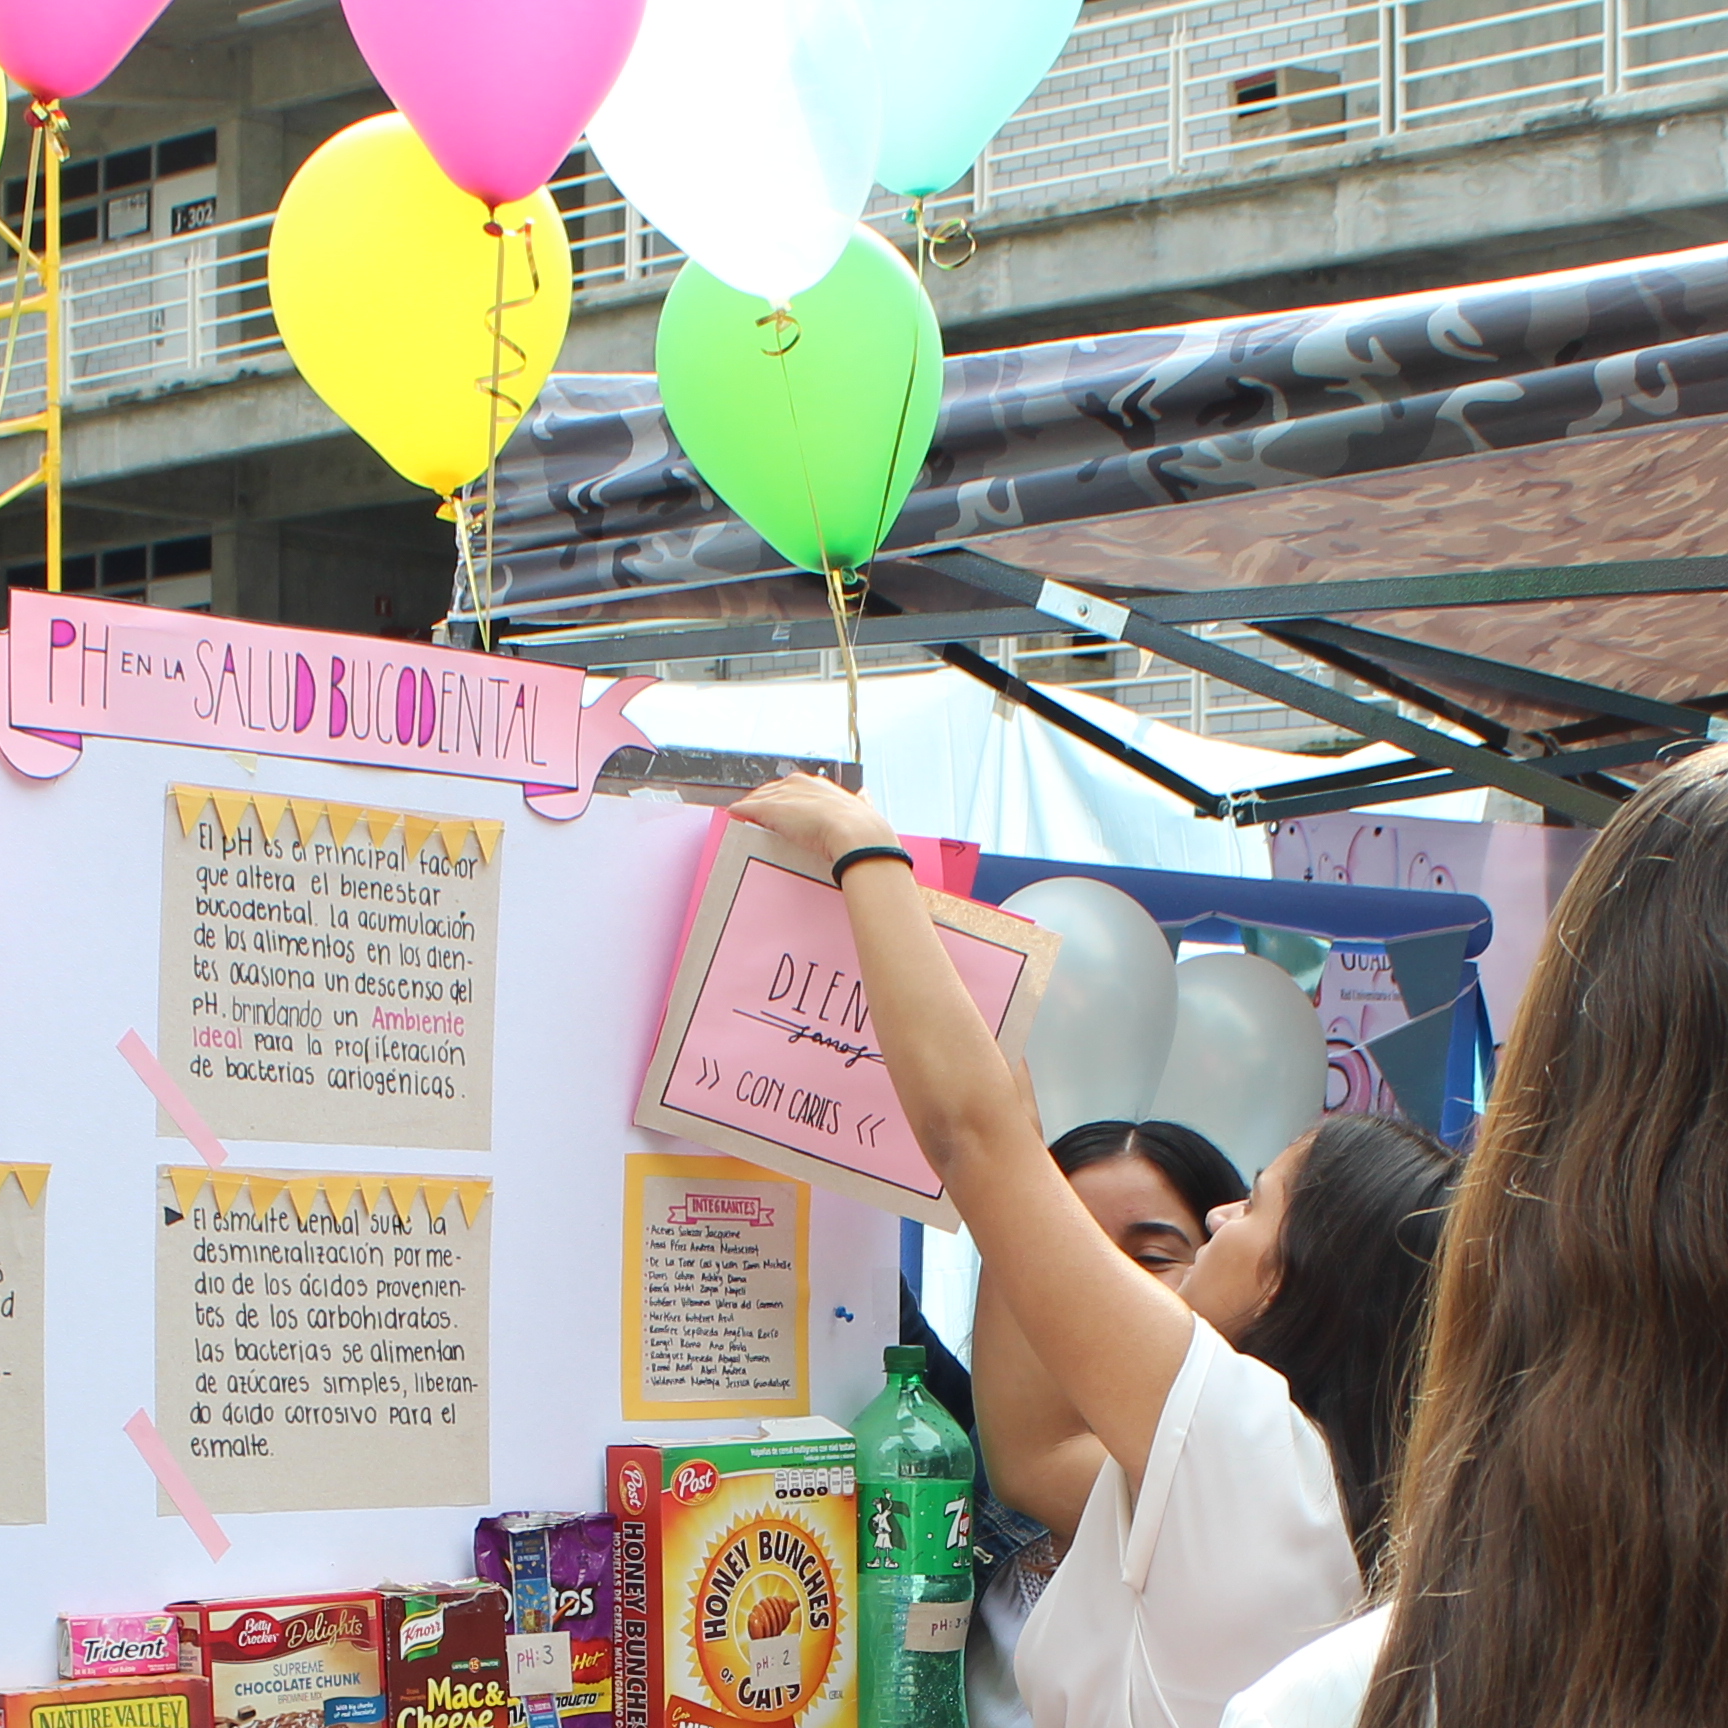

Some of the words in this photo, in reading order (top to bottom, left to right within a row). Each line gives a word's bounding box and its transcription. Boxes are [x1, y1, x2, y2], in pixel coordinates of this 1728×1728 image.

[49, 618, 109, 709] PH
[121, 652, 151, 675] EN
[164, 658, 185, 682] LA
[193, 639, 315, 734] SALUD
[329, 655, 547, 766] BUCODENTAL
[199, 823, 212, 850] El
[222, 826, 252, 860] pH
[264, 839, 283, 860] es
[315, 843, 405, 872] principal
[196, 865, 229, 895] que
[236, 865, 295, 892] altera
[311, 872, 329, 896] el
[341, 874, 441, 906] bienestar
[196, 896, 319, 927] bucodental.
[358, 910, 475, 942] acumulación
[194, 922, 216, 950] de
[224, 924, 247, 952] los
[254, 929, 355, 964] alimentos
[367, 942, 391, 966] en
[399, 943, 421, 967] los
[427, 946, 473, 971] dien-
[193, 954, 219, 982] tes
[230, 961, 315, 989] ocasiona
[325, 971, 349, 992] un
[355, 972, 443, 1001] descenso
[450, 977, 472, 1005] del
[233, 996, 322, 1029] brindando
[334, 1009, 358, 1027] un
[372, 1005, 465, 1037] Ambiente
[192, 1026, 242, 1049] Ideal
[254, 1032, 294, 1052] para
[307, 1033, 322, 1056] la
[190, 1055, 213, 1078] de
[225, 1056, 314, 1085] bacterias
[328, 1066, 466, 1100] cariogénicas.
[736, 1070, 785, 1112] CON
[788, 1089, 842, 1135] CARIES
[194, 1208, 205, 1231] El
[213, 1207, 290, 1233] esmalte
[429, 1211, 447, 1235] la
[693, 1198, 756, 1215] INTEGRANTES
[194, 1237, 384, 1267] desmineralización
[394, 1247, 420, 1267] por
[194, 1272, 224, 1295] dio
[232, 1272, 254, 1295] de
[264, 1273, 291, 1297] los
[300, 1273, 368, 1297] ácidos
[376, 1279, 466, 1299] provenien-
[195, 1302, 224, 1328] tes
[235, 1303, 259, 1329] de
[270, 1303, 298, 1329] los
[307, 1305, 458, 1330] carbohidratos.
[234, 1338, 332, 1362] bacterias
[342, 1343, 364, 1363] se
[370, 1339, 465, 1363] alimentan
[195, 1372, 217, 1394] de
[227, 1368, 310, 1395] azúcares
[323, 1372, 408, 1398] simples,
[190, 1402, 211, 1424] do
[285, 1406, 377, 1425] corrosivo
[389, 1405, 432, 1425] para
[441, 1403, 456, 1425] el
[191, 1433, 274, 1458] esmalte.
[624, 1469, 643, 1508] Post
[678, 1467, 713, 1498] Post
[613, 1532, 621, 1587] HOJUELAS
[623, 1522, 646, 1614] HONEY
[614, 1589, 621, 1602] DE
[703, 1539, 751, 1641] HONEY
[758, 1530, 829, 1629] BUNCHES
[238, 1631, 279, 1647] Crocker
[245, 1618, 272, 1633] Betty
[285, 1609, 363, 1649] Delights
[402, 1620, 441, 1644] Knorr
[614, 1606, 622, 1645] CEREAL
[81, 1636, 168, 1665] Trident
[517, 1648, 539, 1674] pH:
[543, 1645, 554, 1665] 3
[572, 1650, 605, 1671] Hot
[783, 1650, 790, 1666] 2
[273, 1660, 324, 1677] SUPREME
[614, 1647, 624, 1717] MULTIGRANO
[720, 1668, 734, 1683] OF
[234, 1677, 312, 1696] CHOCOLATE
[316, 1673, 361, 1688] CHUNK
[672, 1706, 691, 1721] Con
